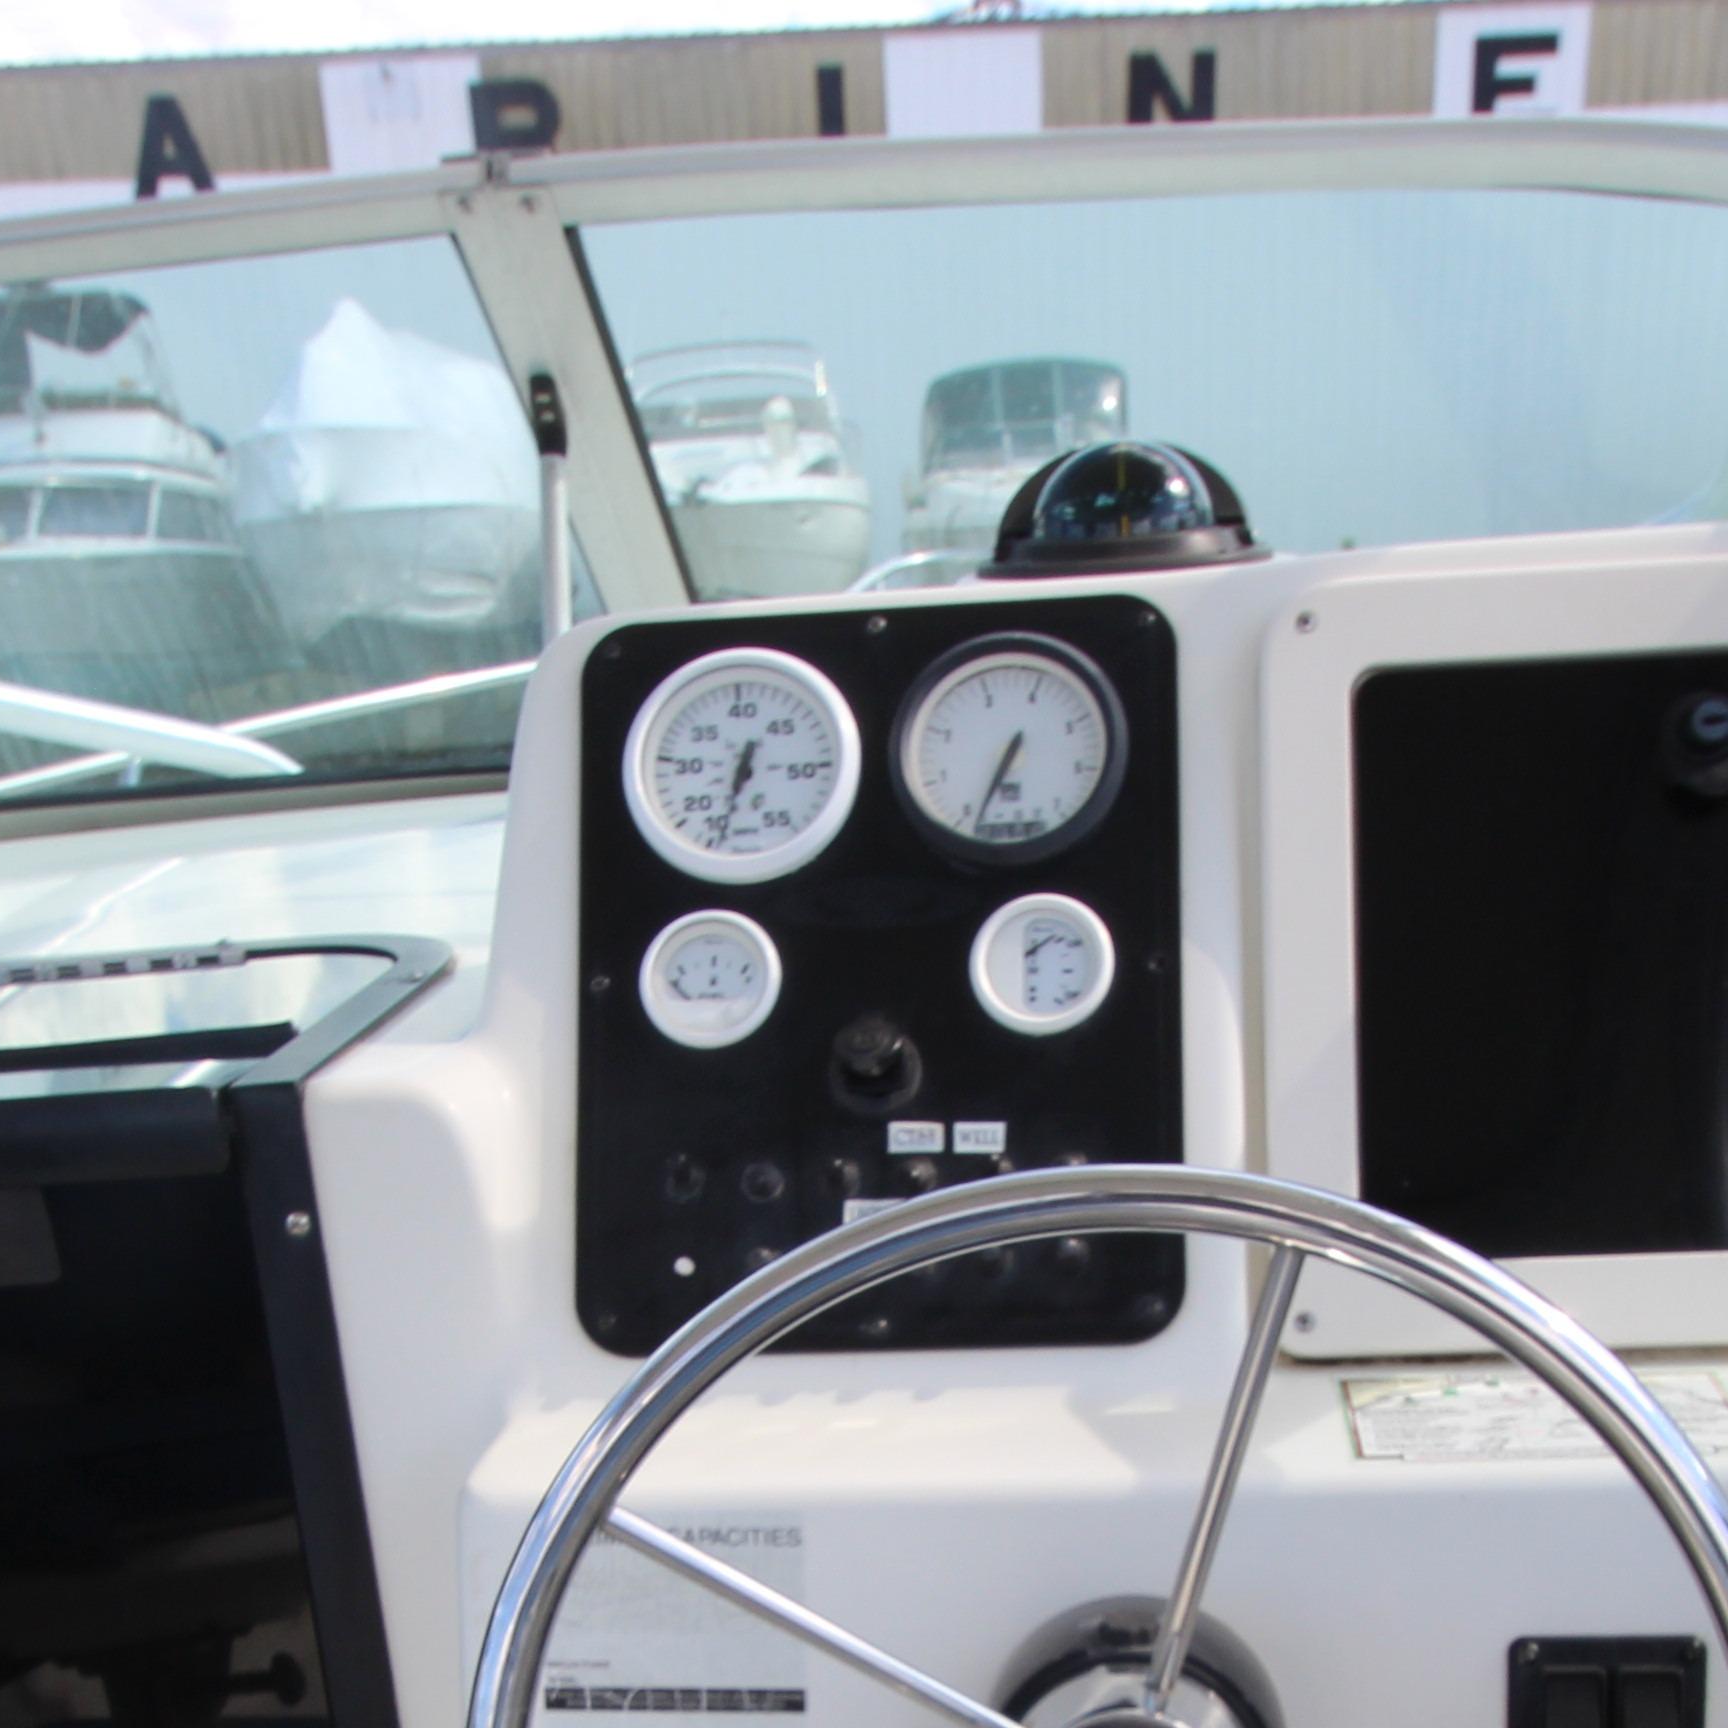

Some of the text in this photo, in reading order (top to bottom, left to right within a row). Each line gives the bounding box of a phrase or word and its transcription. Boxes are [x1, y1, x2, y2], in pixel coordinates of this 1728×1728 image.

[728, 703, 758, 719] 40
[689, 724, 720, 742] 35
[765, 719, 795, 736] 45
[674, 758, 704, 775] 30
[786, 762, 817, 780] 50
[683, 795, 712, 812] 20
[703, 814, 730, 832] 10
[762, 810, 791, 829] 55
